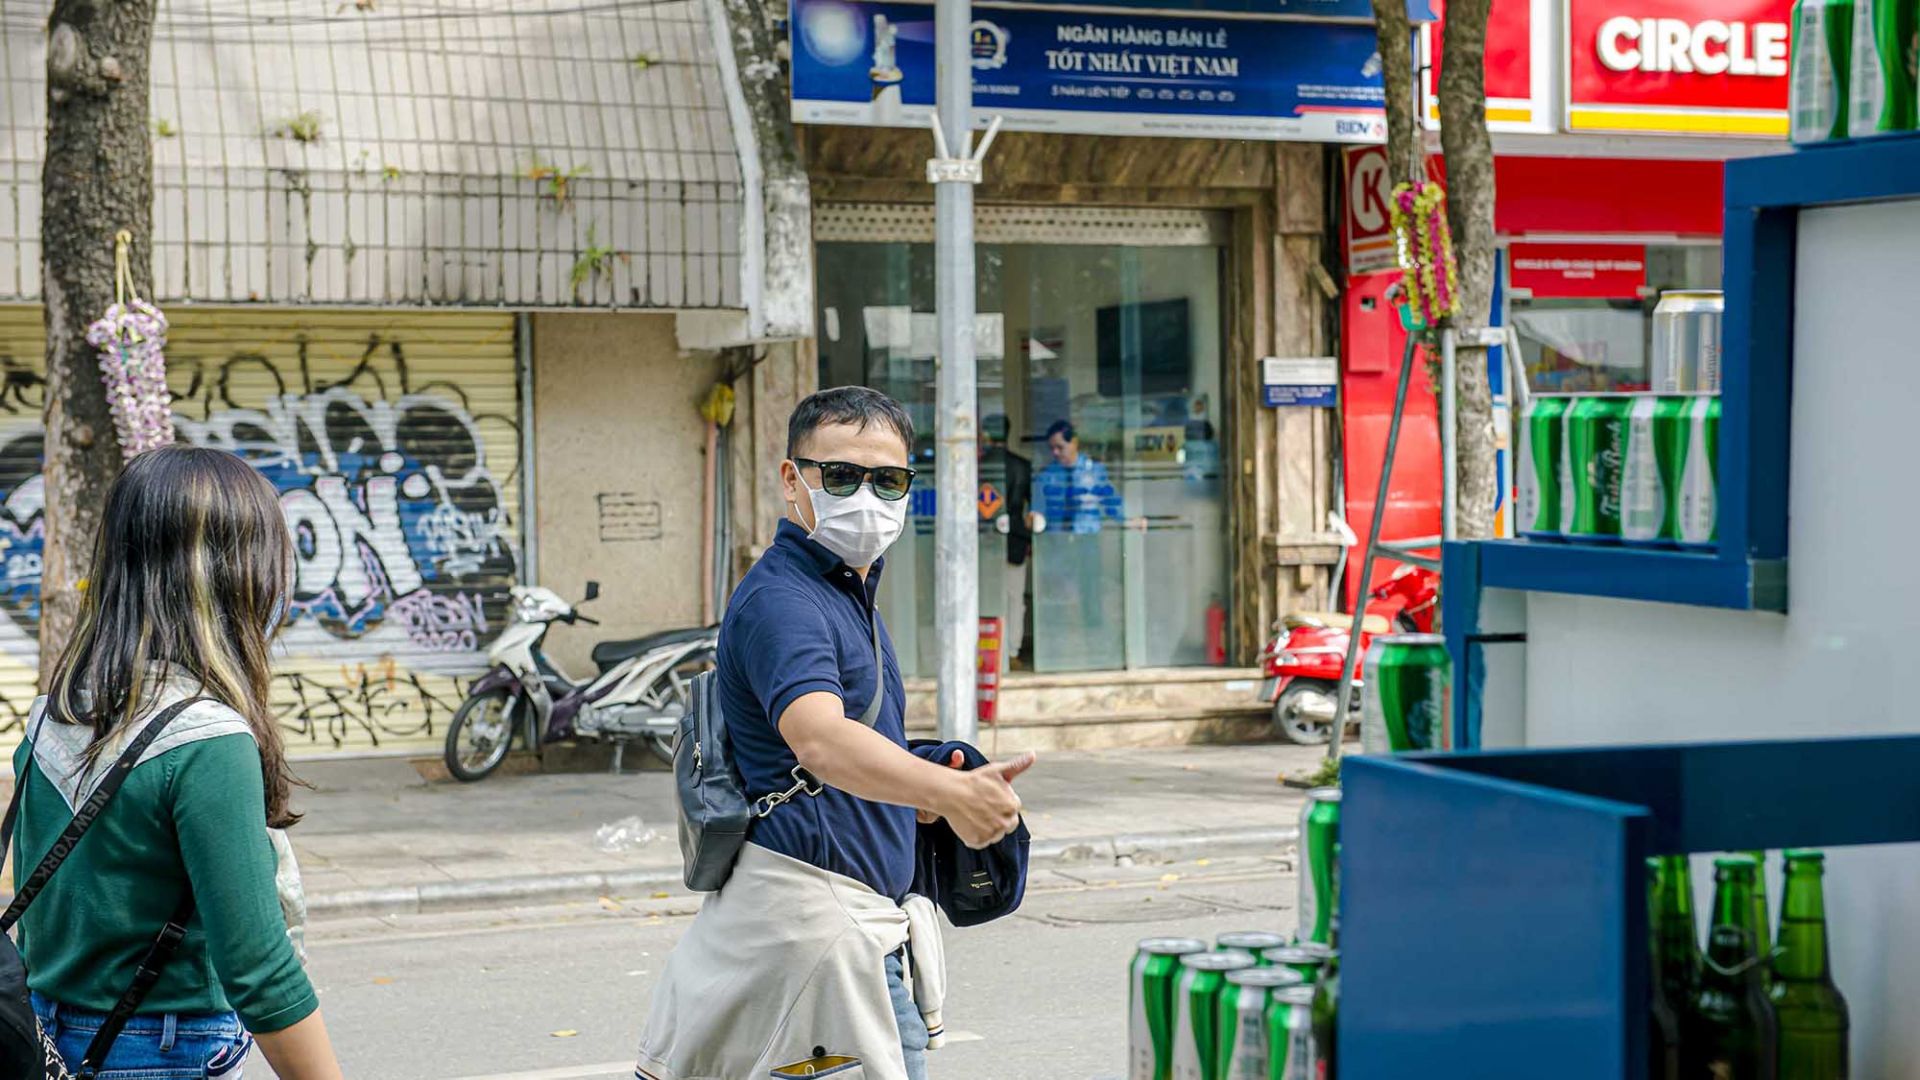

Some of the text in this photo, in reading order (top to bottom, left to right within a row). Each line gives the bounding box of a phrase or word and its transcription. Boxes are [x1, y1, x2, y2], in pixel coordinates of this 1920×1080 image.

[1057, 23, 1108, 43] NGÂN
[1112, 25, 1163, 46] HÀNG
[1597, 16, 1787, 76] CIRCLE
[1146, 53, 1192, 78] VIỆT
[1194, 57, 1239, 77] NAM
[1336, 120, 1370, 135] BIDV
[76, 790, 111, 833] NEW
[40, 834, 79, 882] YORK
